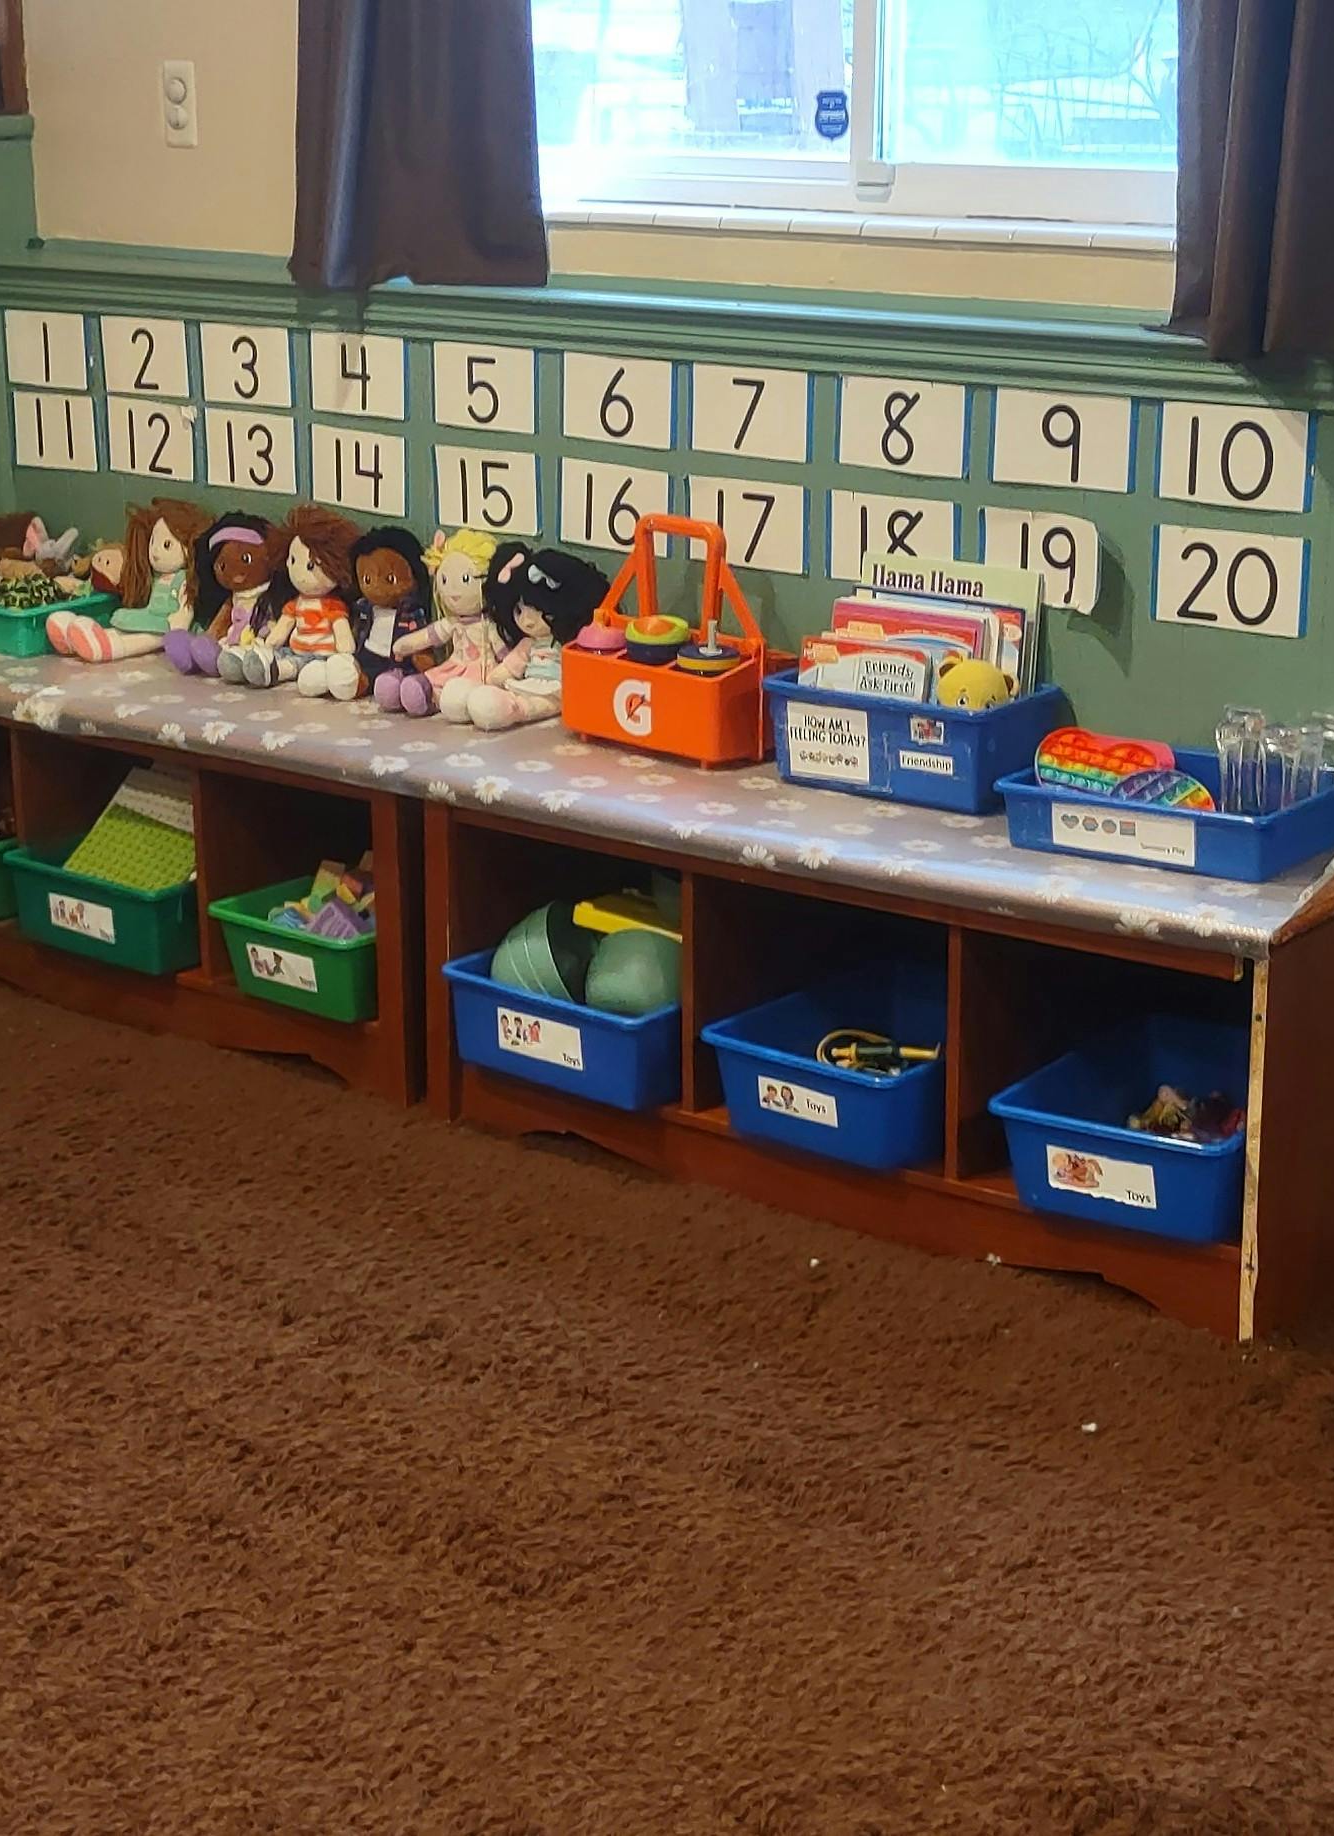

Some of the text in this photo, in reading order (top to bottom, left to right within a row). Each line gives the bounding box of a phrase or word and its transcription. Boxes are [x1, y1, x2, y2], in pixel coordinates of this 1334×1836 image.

[42, 321, 51, 383] 1
[131, 328, 160, 390] 2
[231, 335, 259, 399] 3
[340, 343, 371, 411] 4
[466, 356, 500, 424] 5
[600, 367, 634, 437] 6
[732, 377, 765, 450] 7
[35, 397, 74, 461] 11
[127, 407, 174, 476] 12
[226, 419, 275, 486] 13
[880, 391, 921, 465] 8
[1041, 404, 1081, 483] 9
[1188, 415, 1274, 501] 10
[334, 437, 384, 509] 14
[459, 457, 514, 528] 15
[585, 473, 641, 546] 16
[717, 489, 776, 563] 17
[859, 504, 924, 580] 18
[873, 563, 983, 598] llama llama
[1020, 521, 1079, 604] 19
[1176, 541, 1279, 626] 20
[613, 678, 653, 736] G
[789, 726, 867, 748] FEELING TODAY?
[804, 715, 826, 730] HOW
[829, 717, 844, 732] AM
[901, 753, 952, 772] Friendship
[806, 1098, 827, 1114] Toys
[1126, 1190, 1151, 1204] Toys
